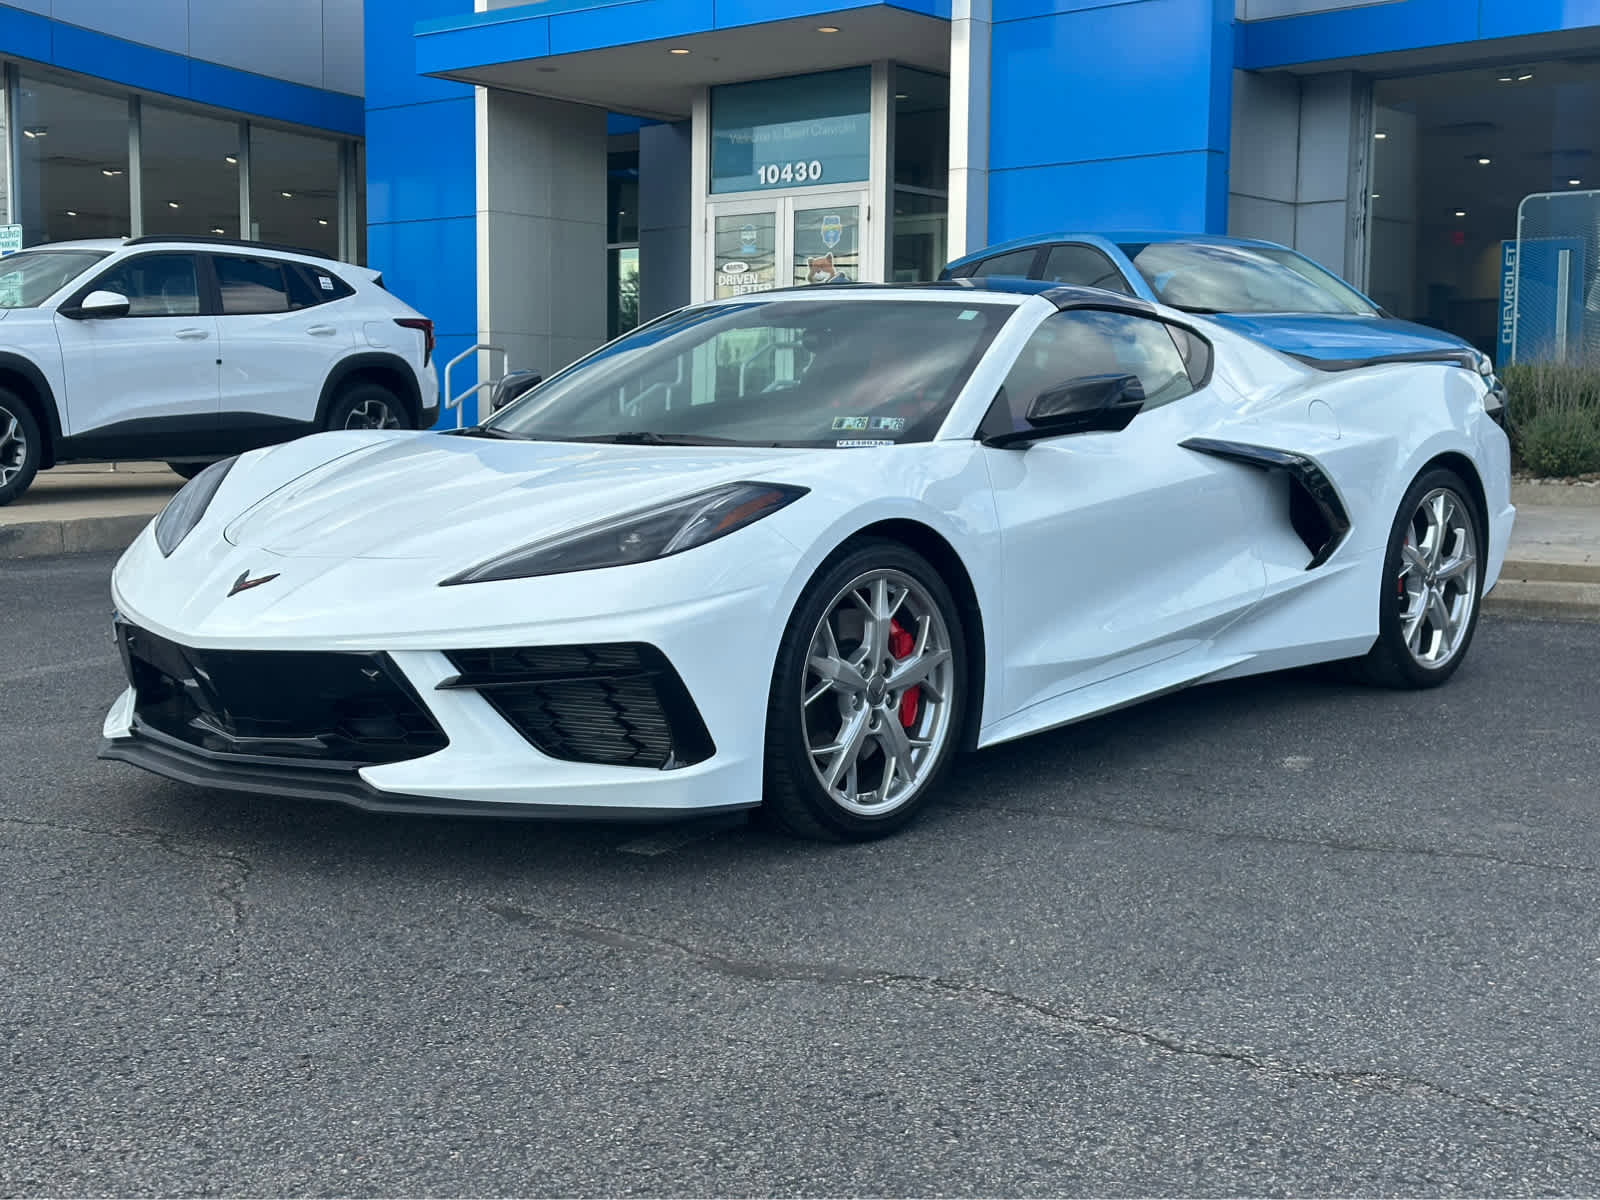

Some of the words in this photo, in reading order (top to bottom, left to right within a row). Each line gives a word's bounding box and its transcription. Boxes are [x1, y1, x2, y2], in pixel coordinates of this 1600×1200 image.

[757, 160, 822, 185] 10430
[719, 272, 759, 286] DRIVEN
[1502, 246, 1517, 344] CHEVROLET
